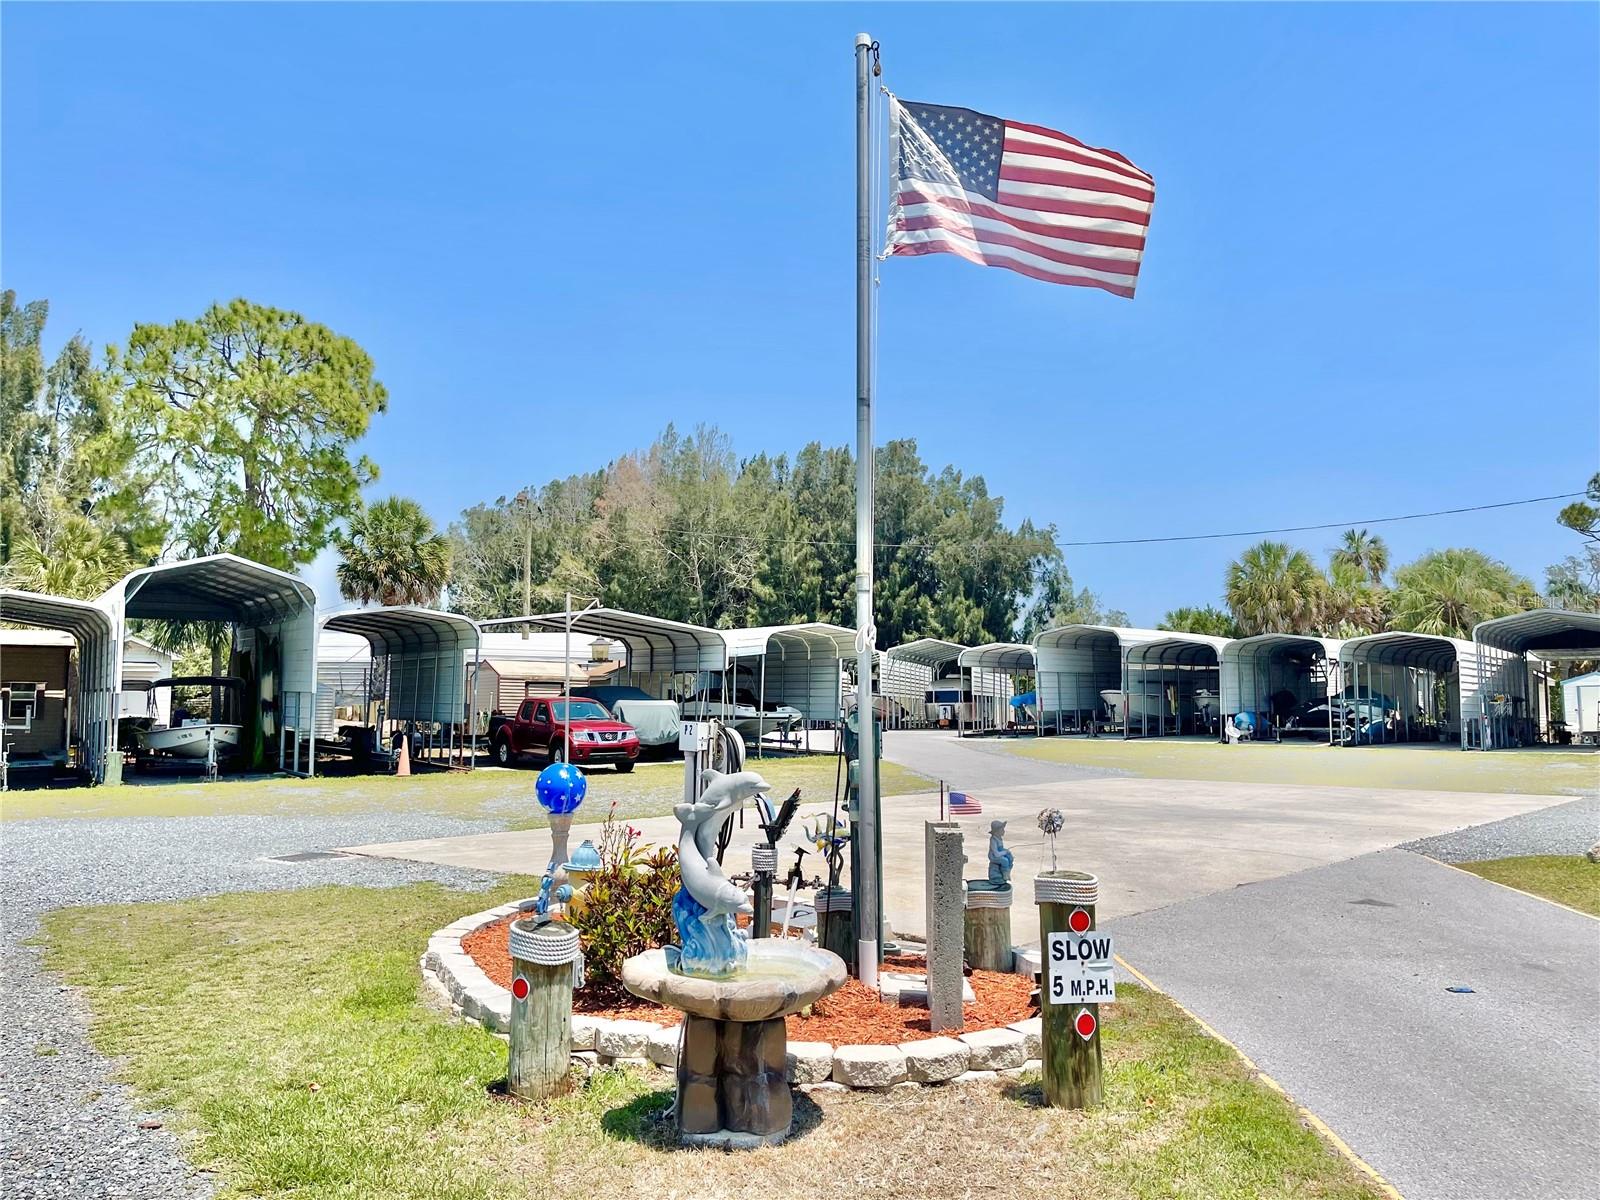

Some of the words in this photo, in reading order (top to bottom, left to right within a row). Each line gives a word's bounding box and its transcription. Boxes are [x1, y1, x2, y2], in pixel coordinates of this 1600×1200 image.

[1052, 938, 1111, 962] SLOW
[1053, 975, 1064, 997] 5
[1071, 979, 1113, 996] M.P.H.
